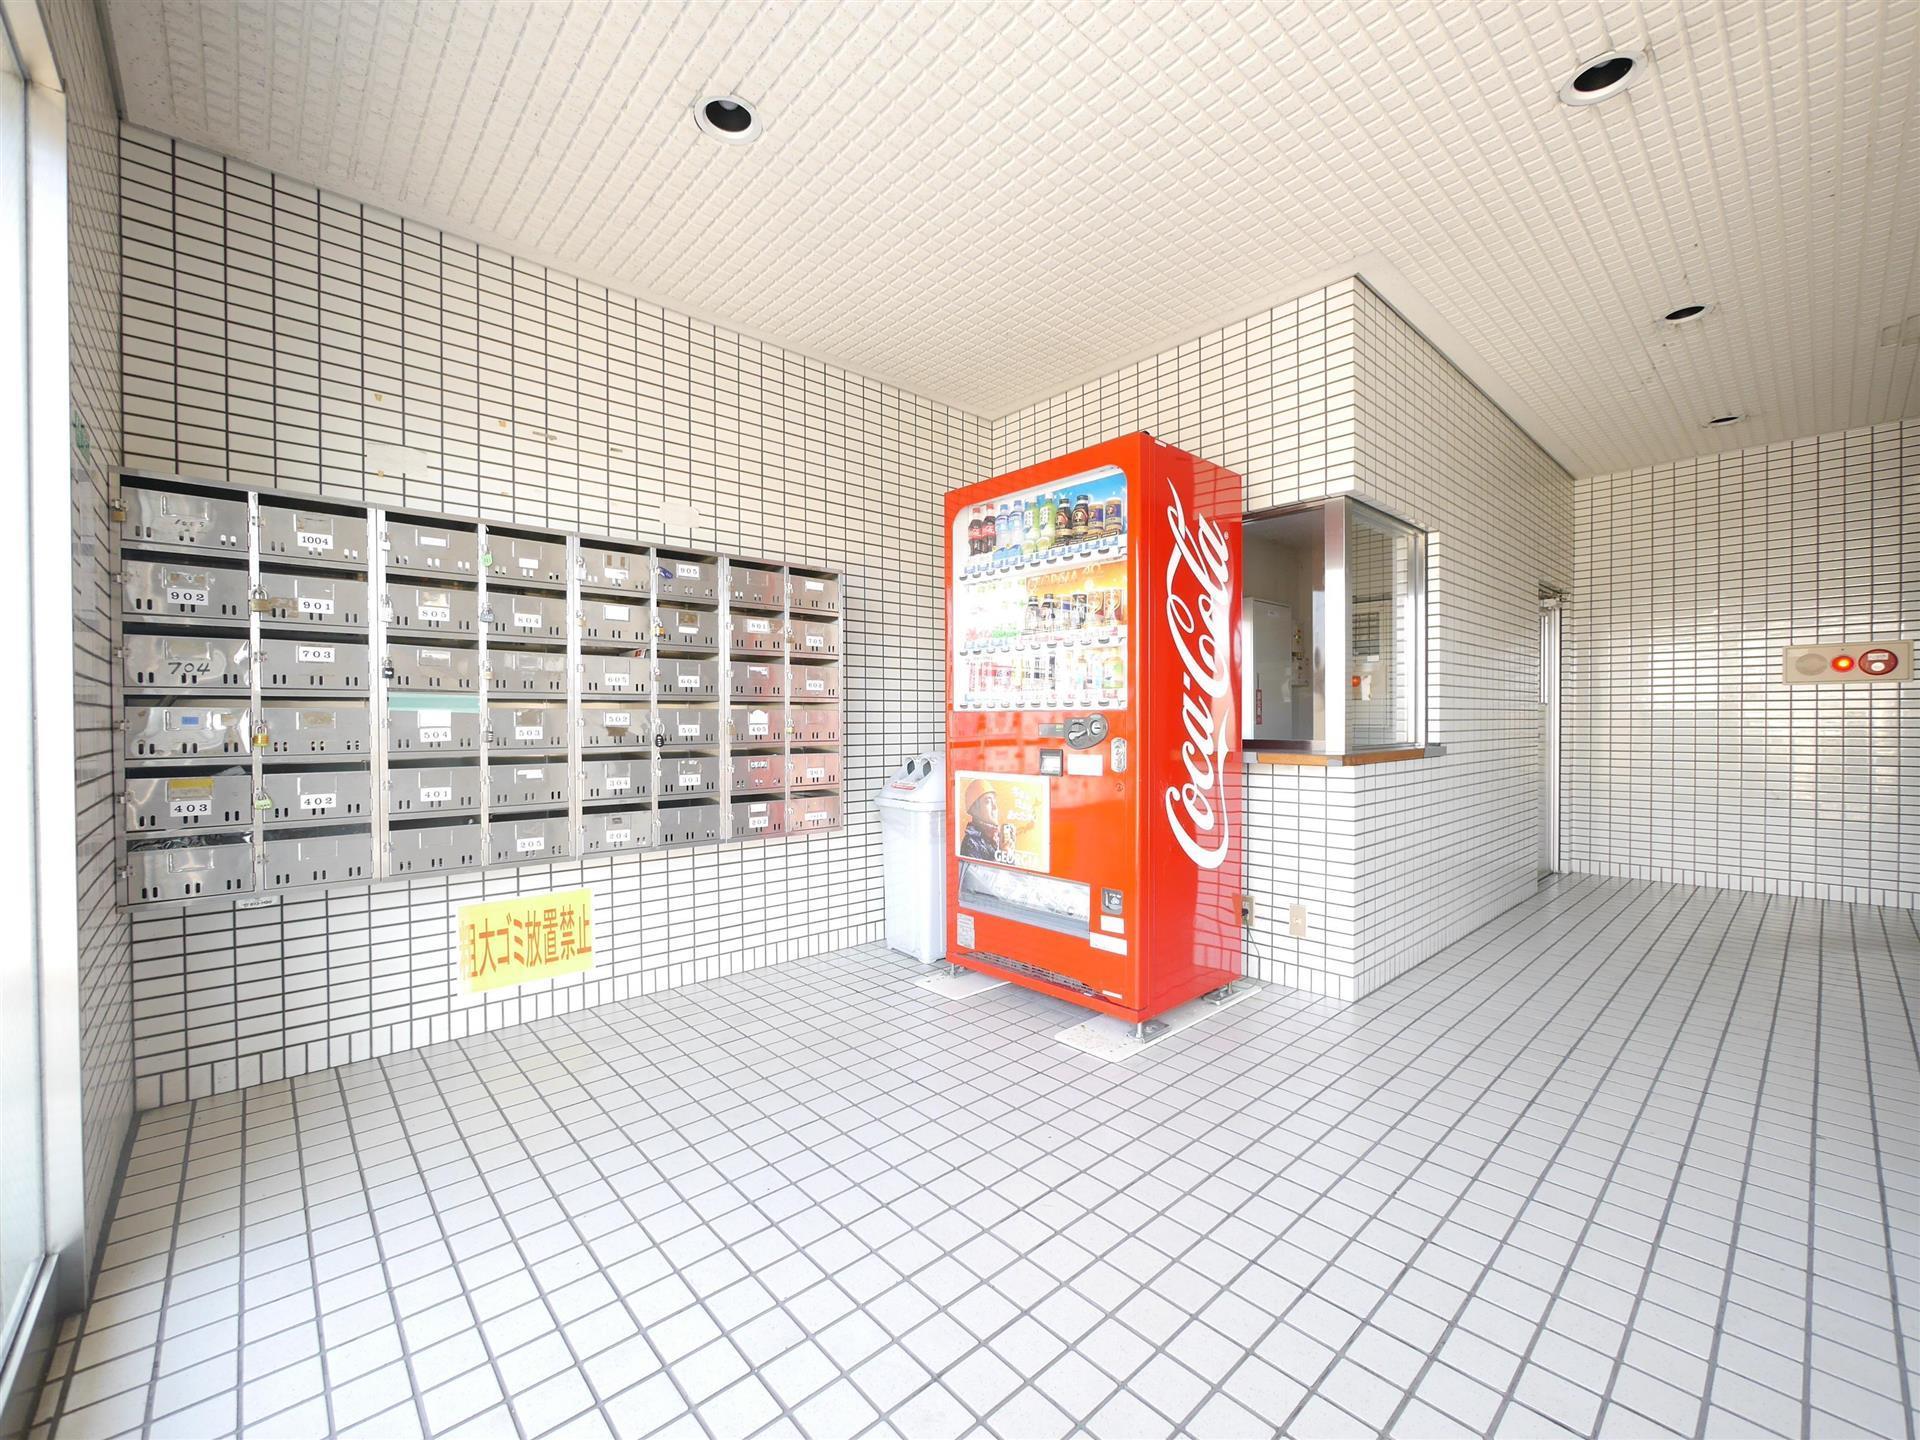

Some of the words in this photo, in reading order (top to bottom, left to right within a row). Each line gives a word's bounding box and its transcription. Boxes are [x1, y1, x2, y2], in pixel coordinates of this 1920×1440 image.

[301, 536, 329, 546] 1004
[170, 591, 206, 602] 902
[302, 601, 331, 611] 901
[422, 610, 448, 619] 805
[302, 650, 331, 659] 703
[168, 662, 211, 677] 704
[1165, 477, 1231, 870] Coca-Cola
[423, 731, 449, 739] 504
[424, 791, 449, 799] 401
[304, 797, 333, 806] 402
[174, 804, 208, 813] 403
[520, 840, 542, 849] 205
